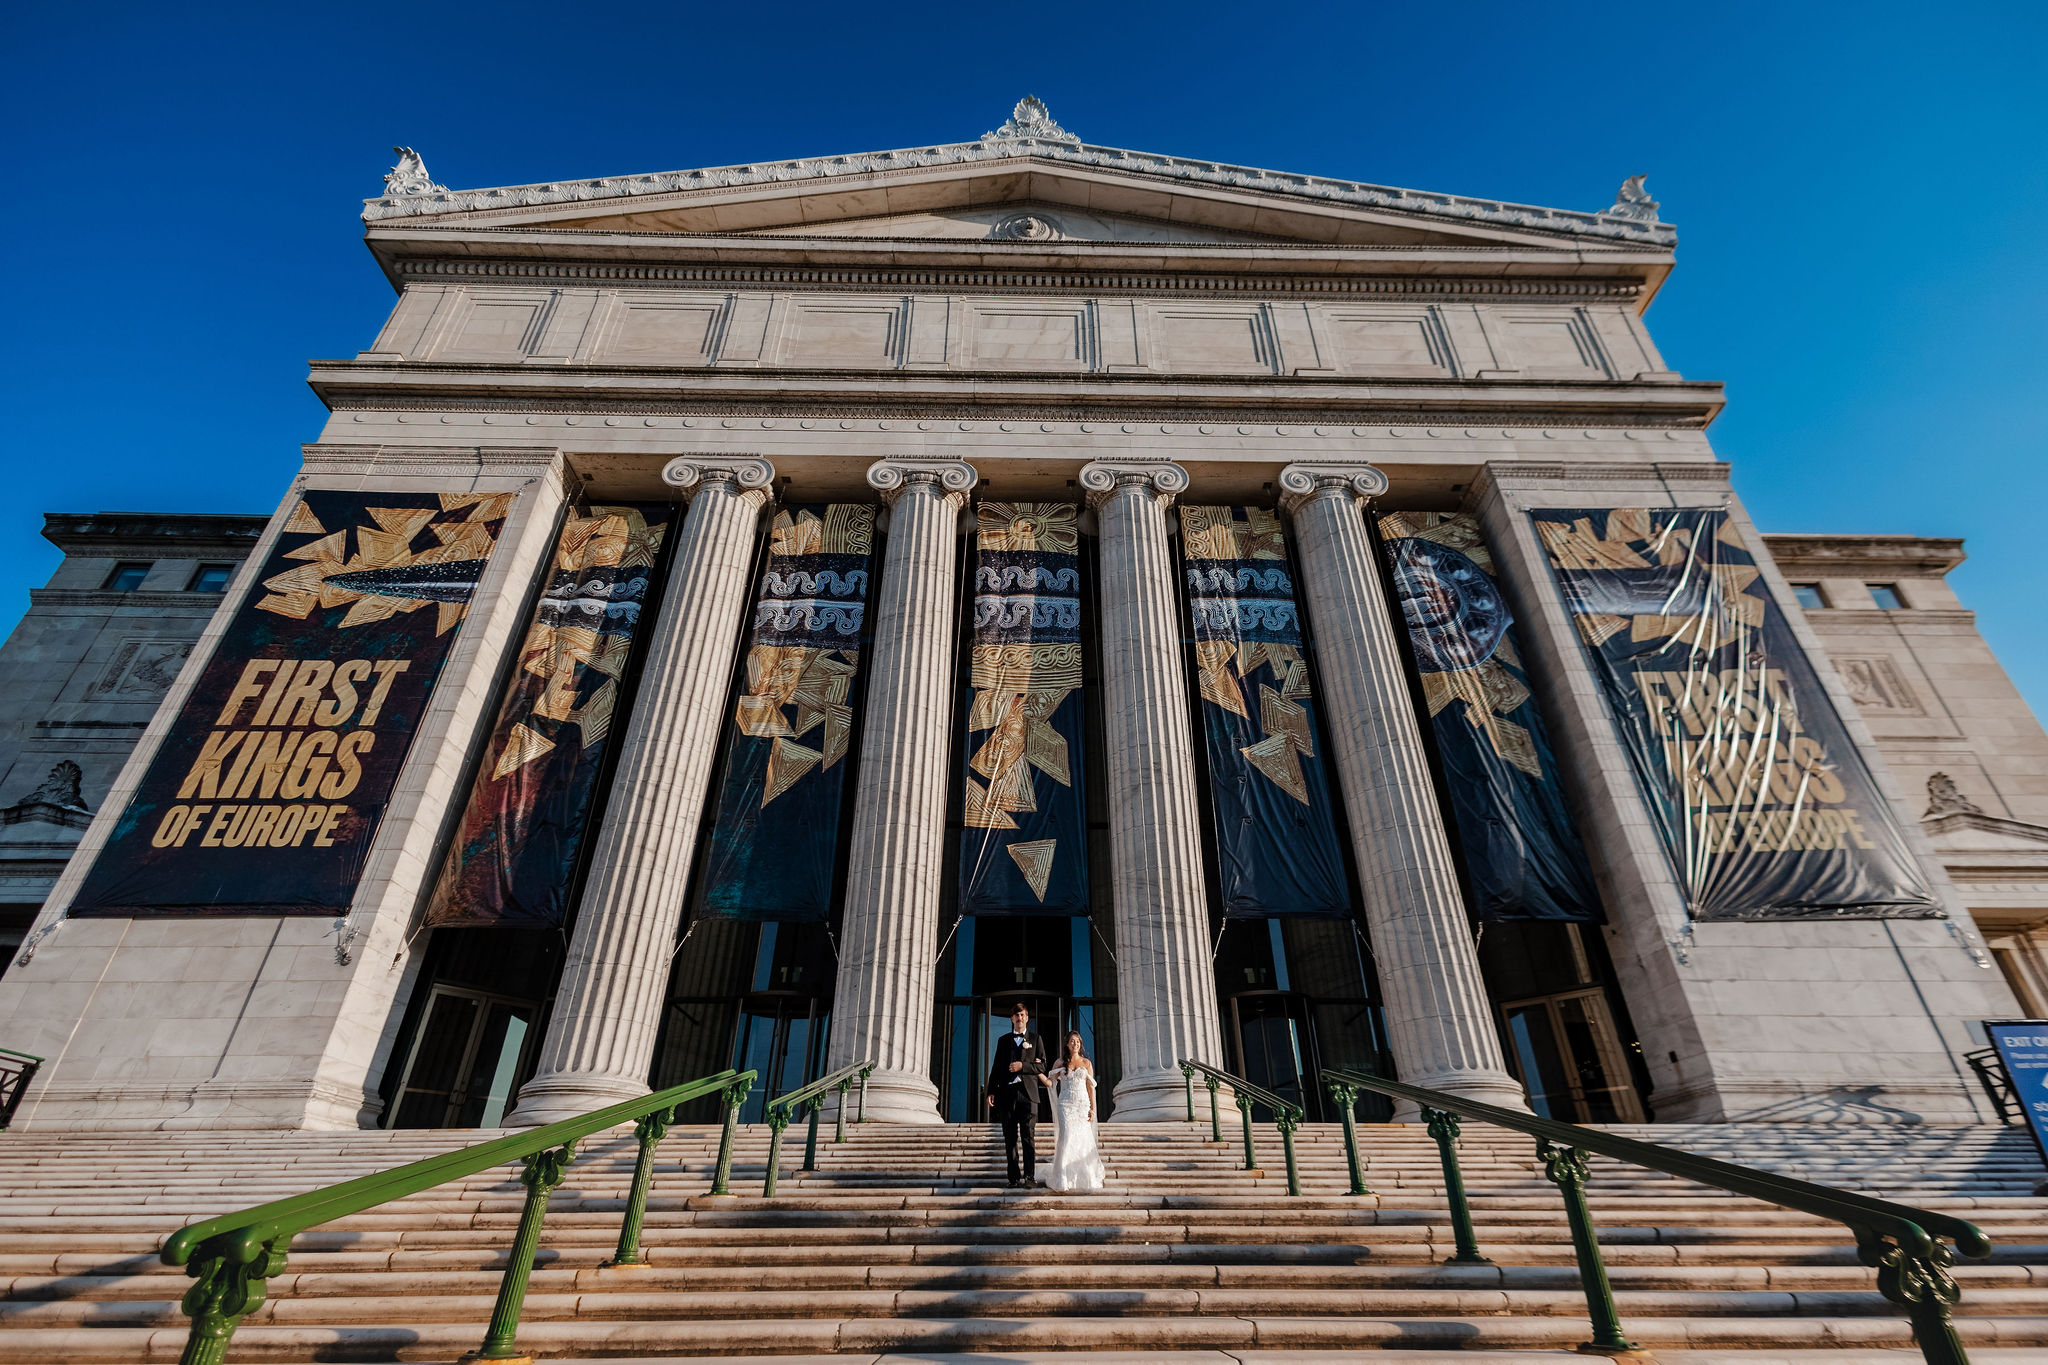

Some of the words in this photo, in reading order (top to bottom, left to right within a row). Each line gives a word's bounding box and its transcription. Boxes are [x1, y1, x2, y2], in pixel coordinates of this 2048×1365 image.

[215, 659, 411, 726] FIRST
[1632, 669, 1804, 735] FIRST
[176, 730, 376, 800] KINGS
[1663, 737, 1846, 806] KINGS
[151, 805, 211, 848] OF
[200, 805, 348, 848] EUROPE
[1738, 809, 1875, 852] EUROPE
[2002, 1036, 2032, 1047] EXIT
